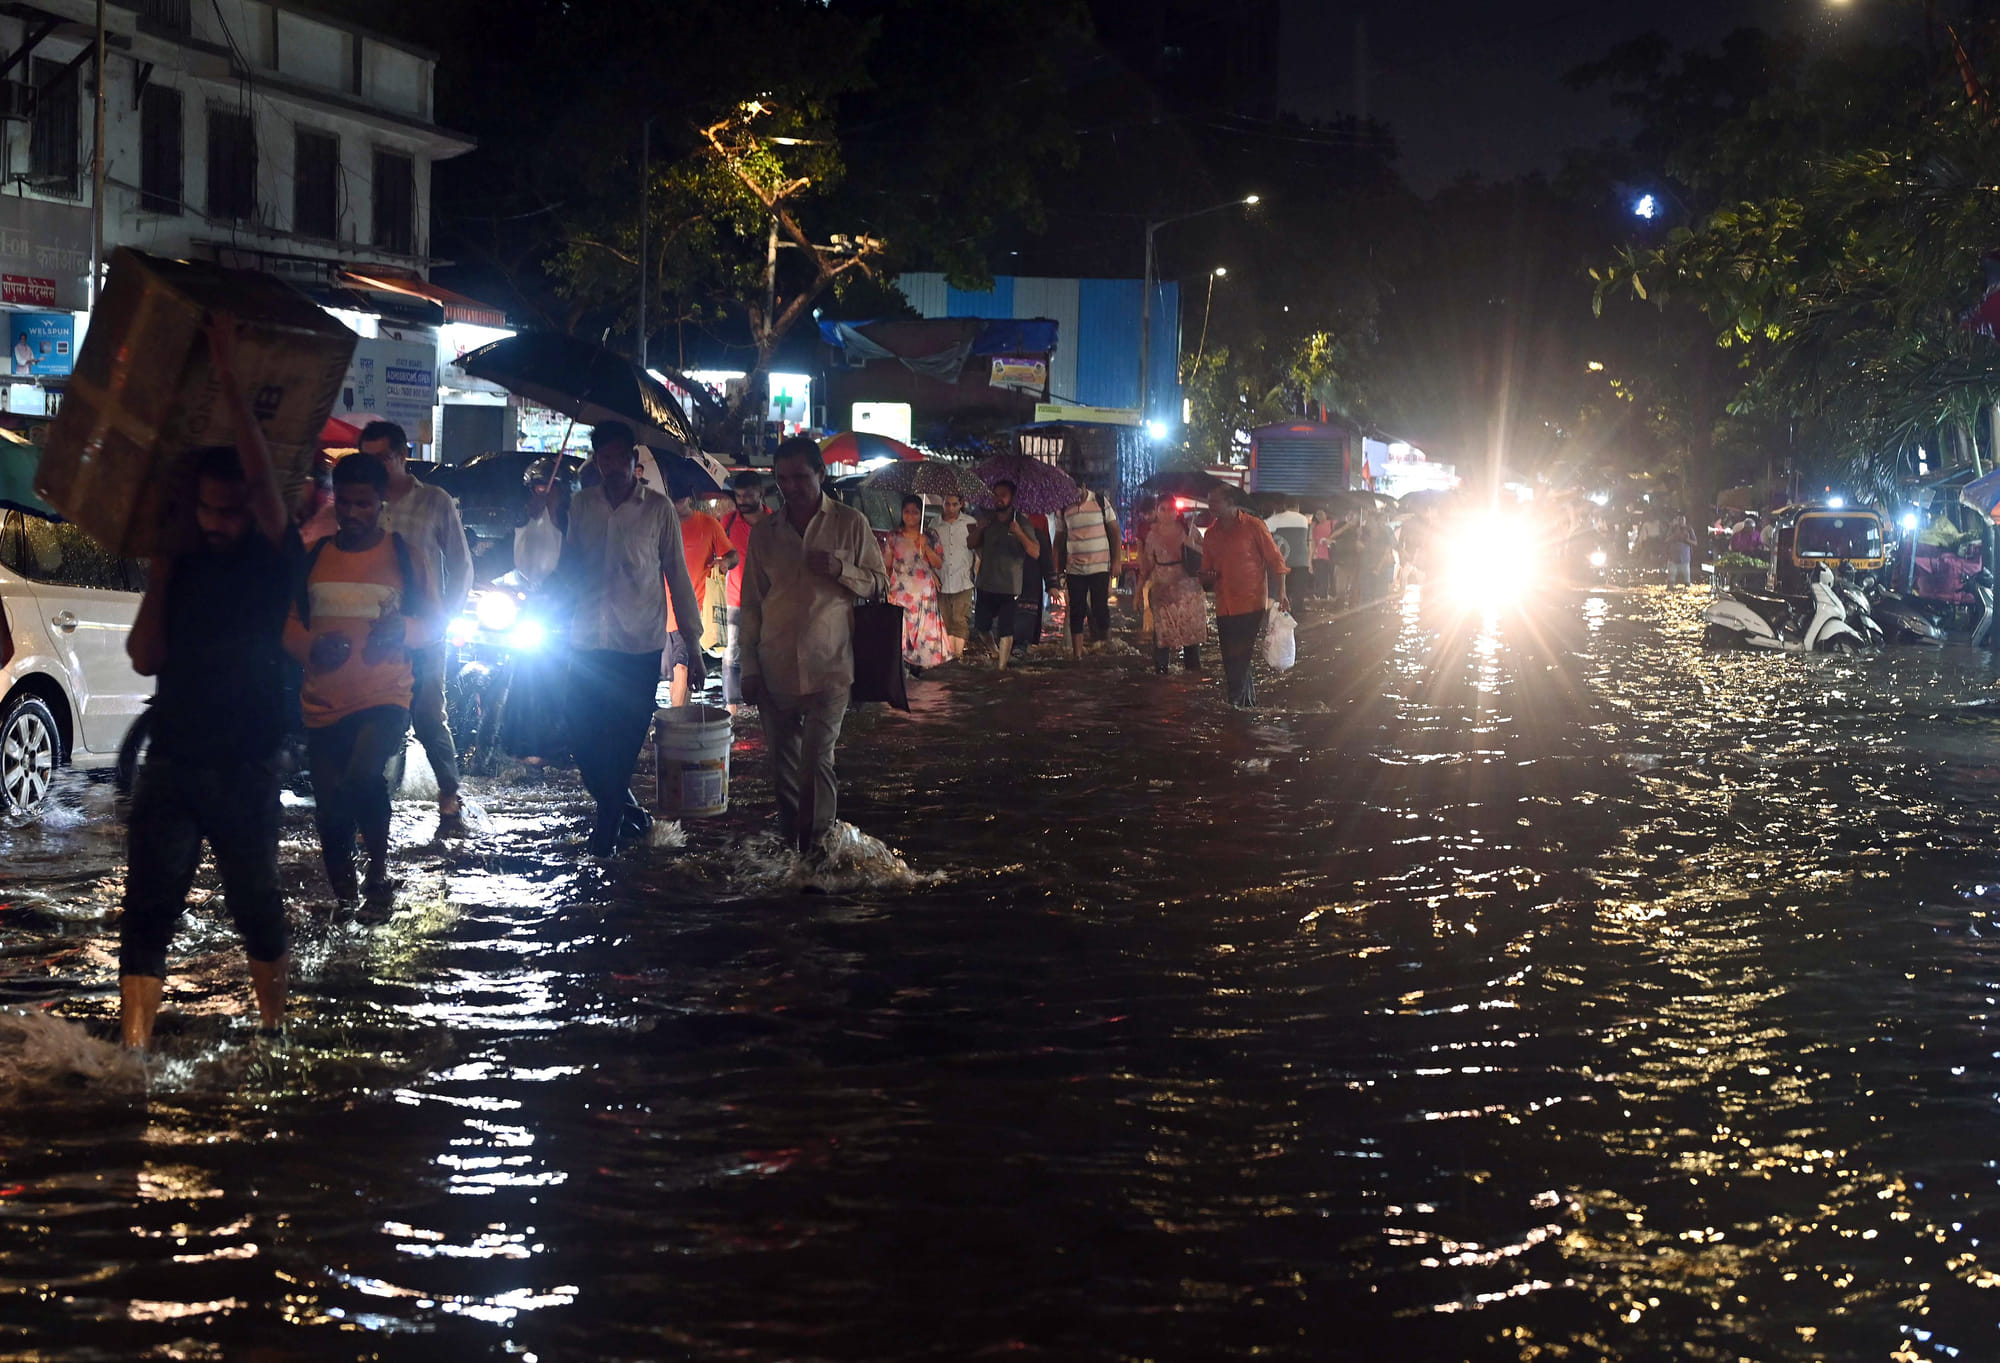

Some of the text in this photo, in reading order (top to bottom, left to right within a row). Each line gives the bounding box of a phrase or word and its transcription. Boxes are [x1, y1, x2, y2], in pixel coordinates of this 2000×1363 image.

[29, 327, 69, 335] WELSPUN
[387, 370, 430, 384] ADMISSIONS OPEN
